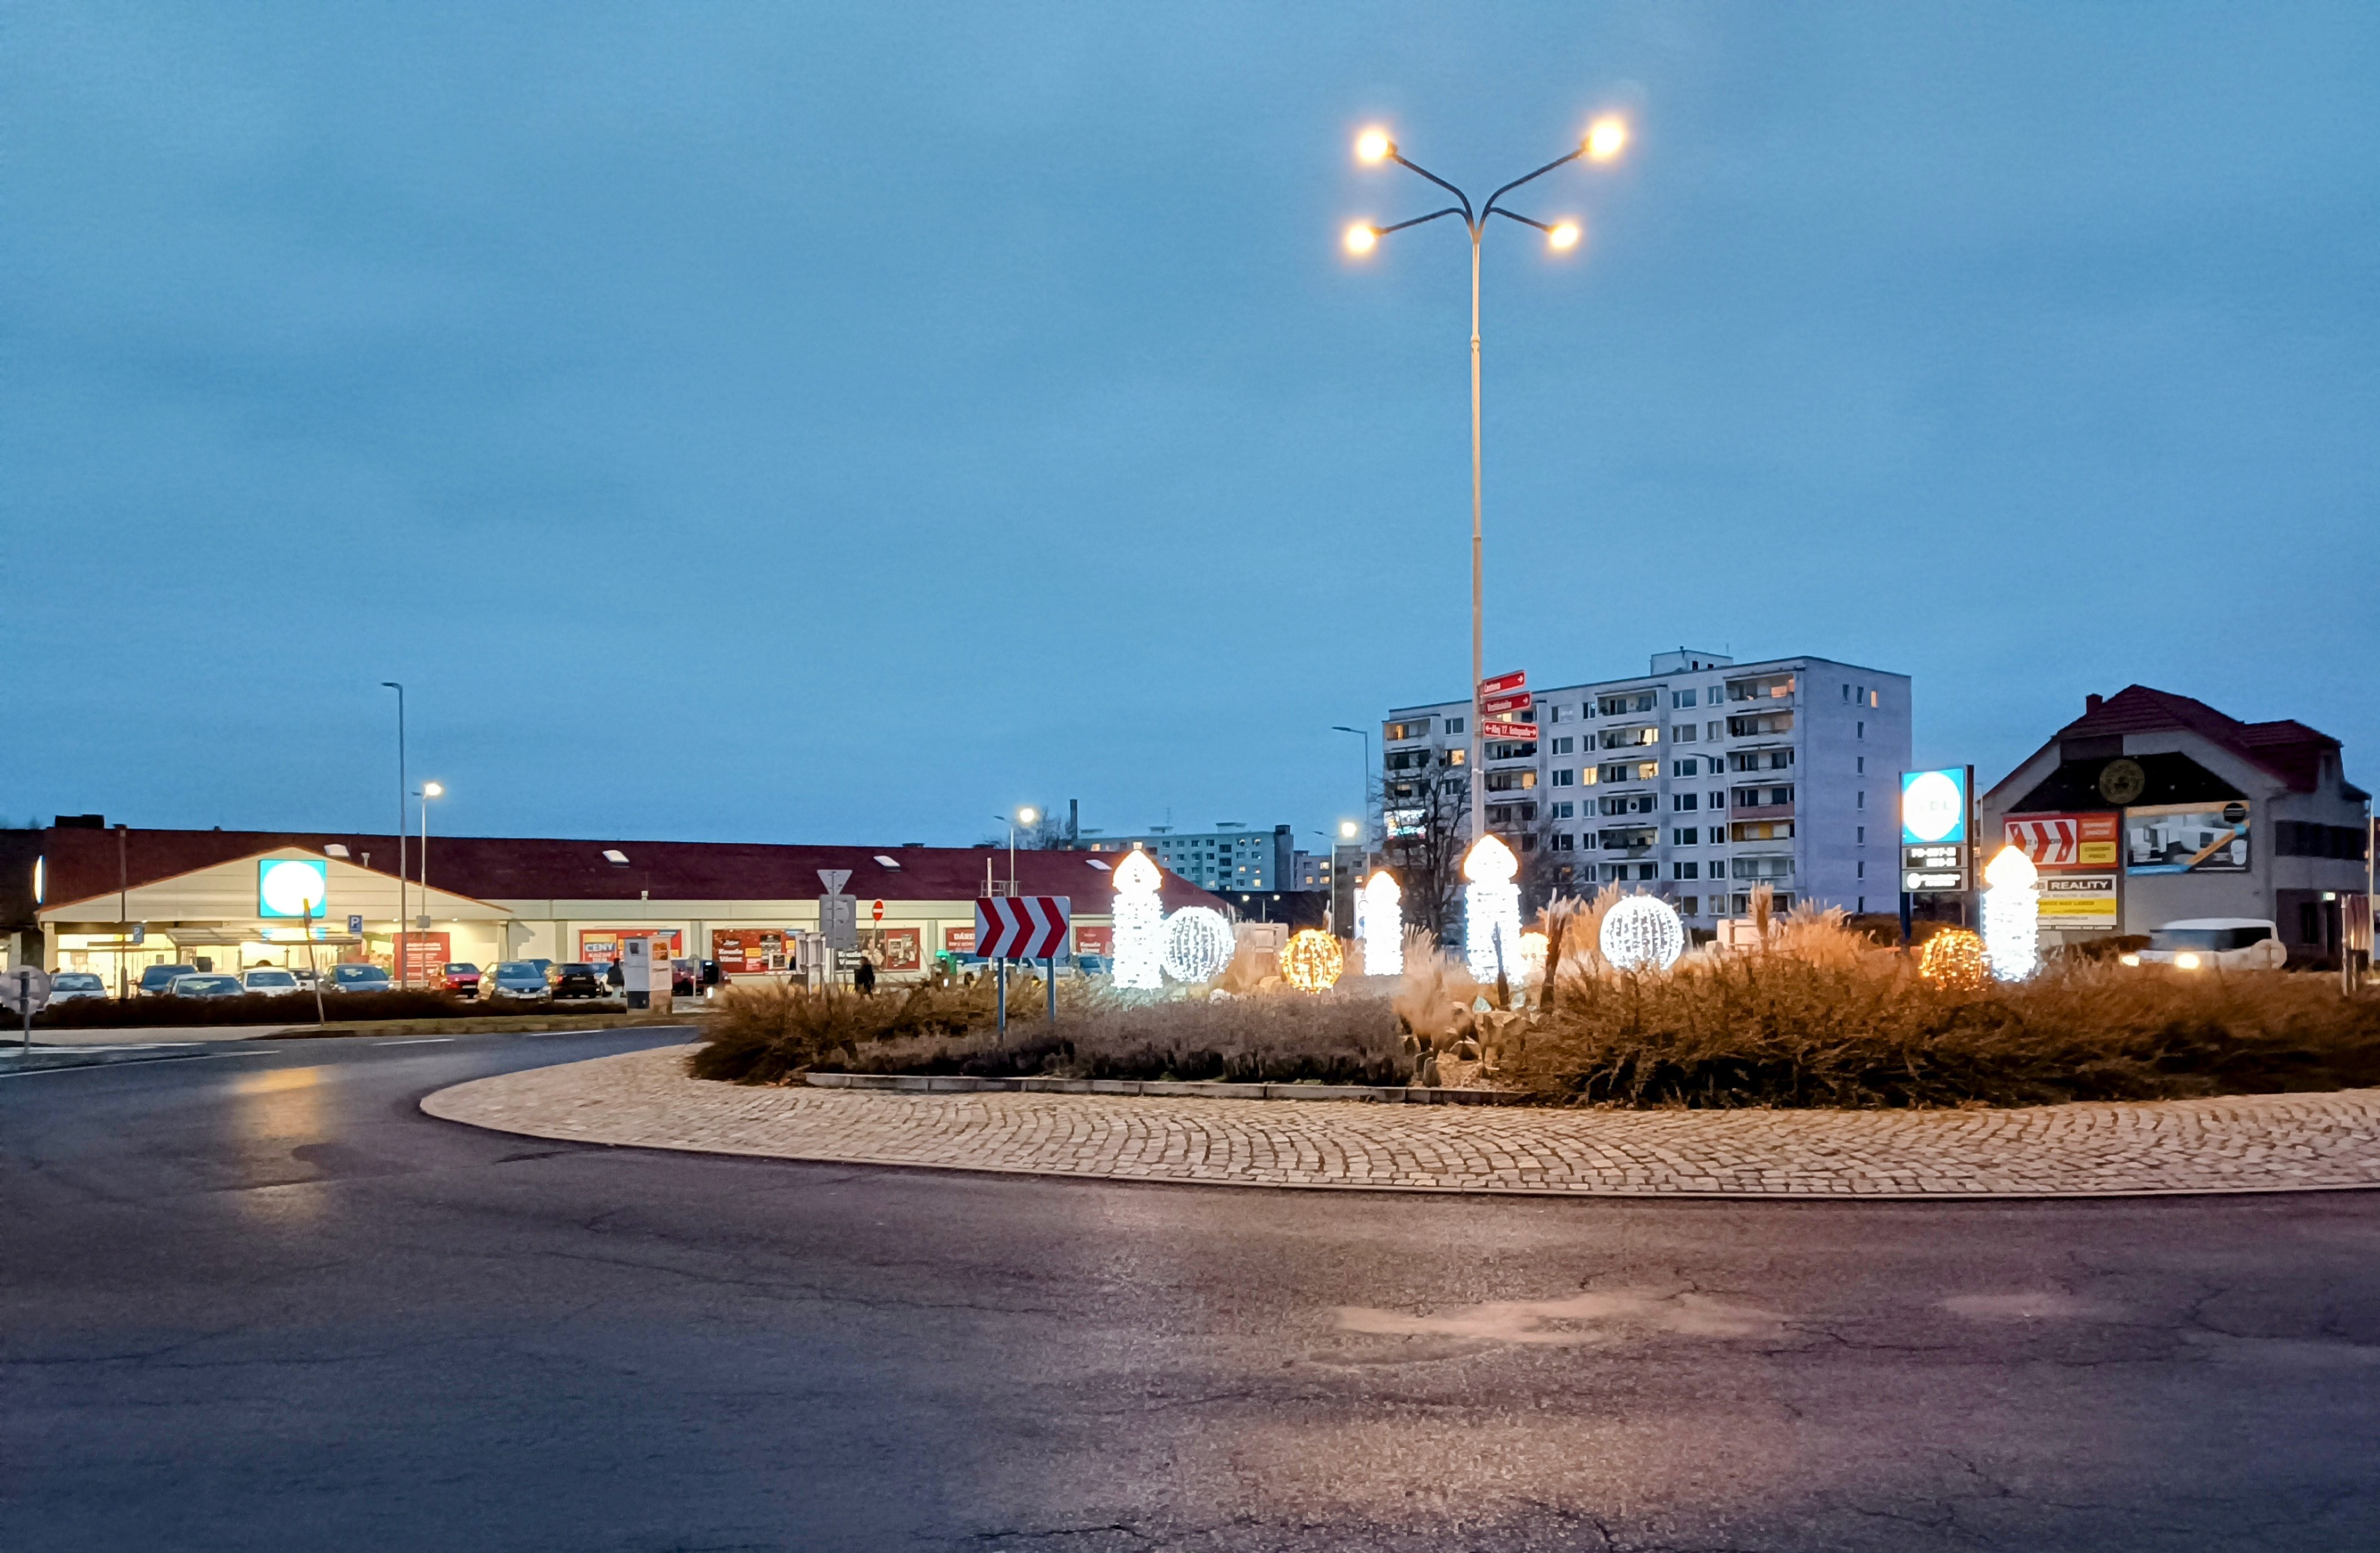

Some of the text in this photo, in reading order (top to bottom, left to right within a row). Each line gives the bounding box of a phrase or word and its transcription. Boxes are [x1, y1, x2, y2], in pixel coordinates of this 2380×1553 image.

[2050, 881, 2108, 889] REALITY
[351, 917, 360, 928] P
[585, 943, 613, 952] CENY
